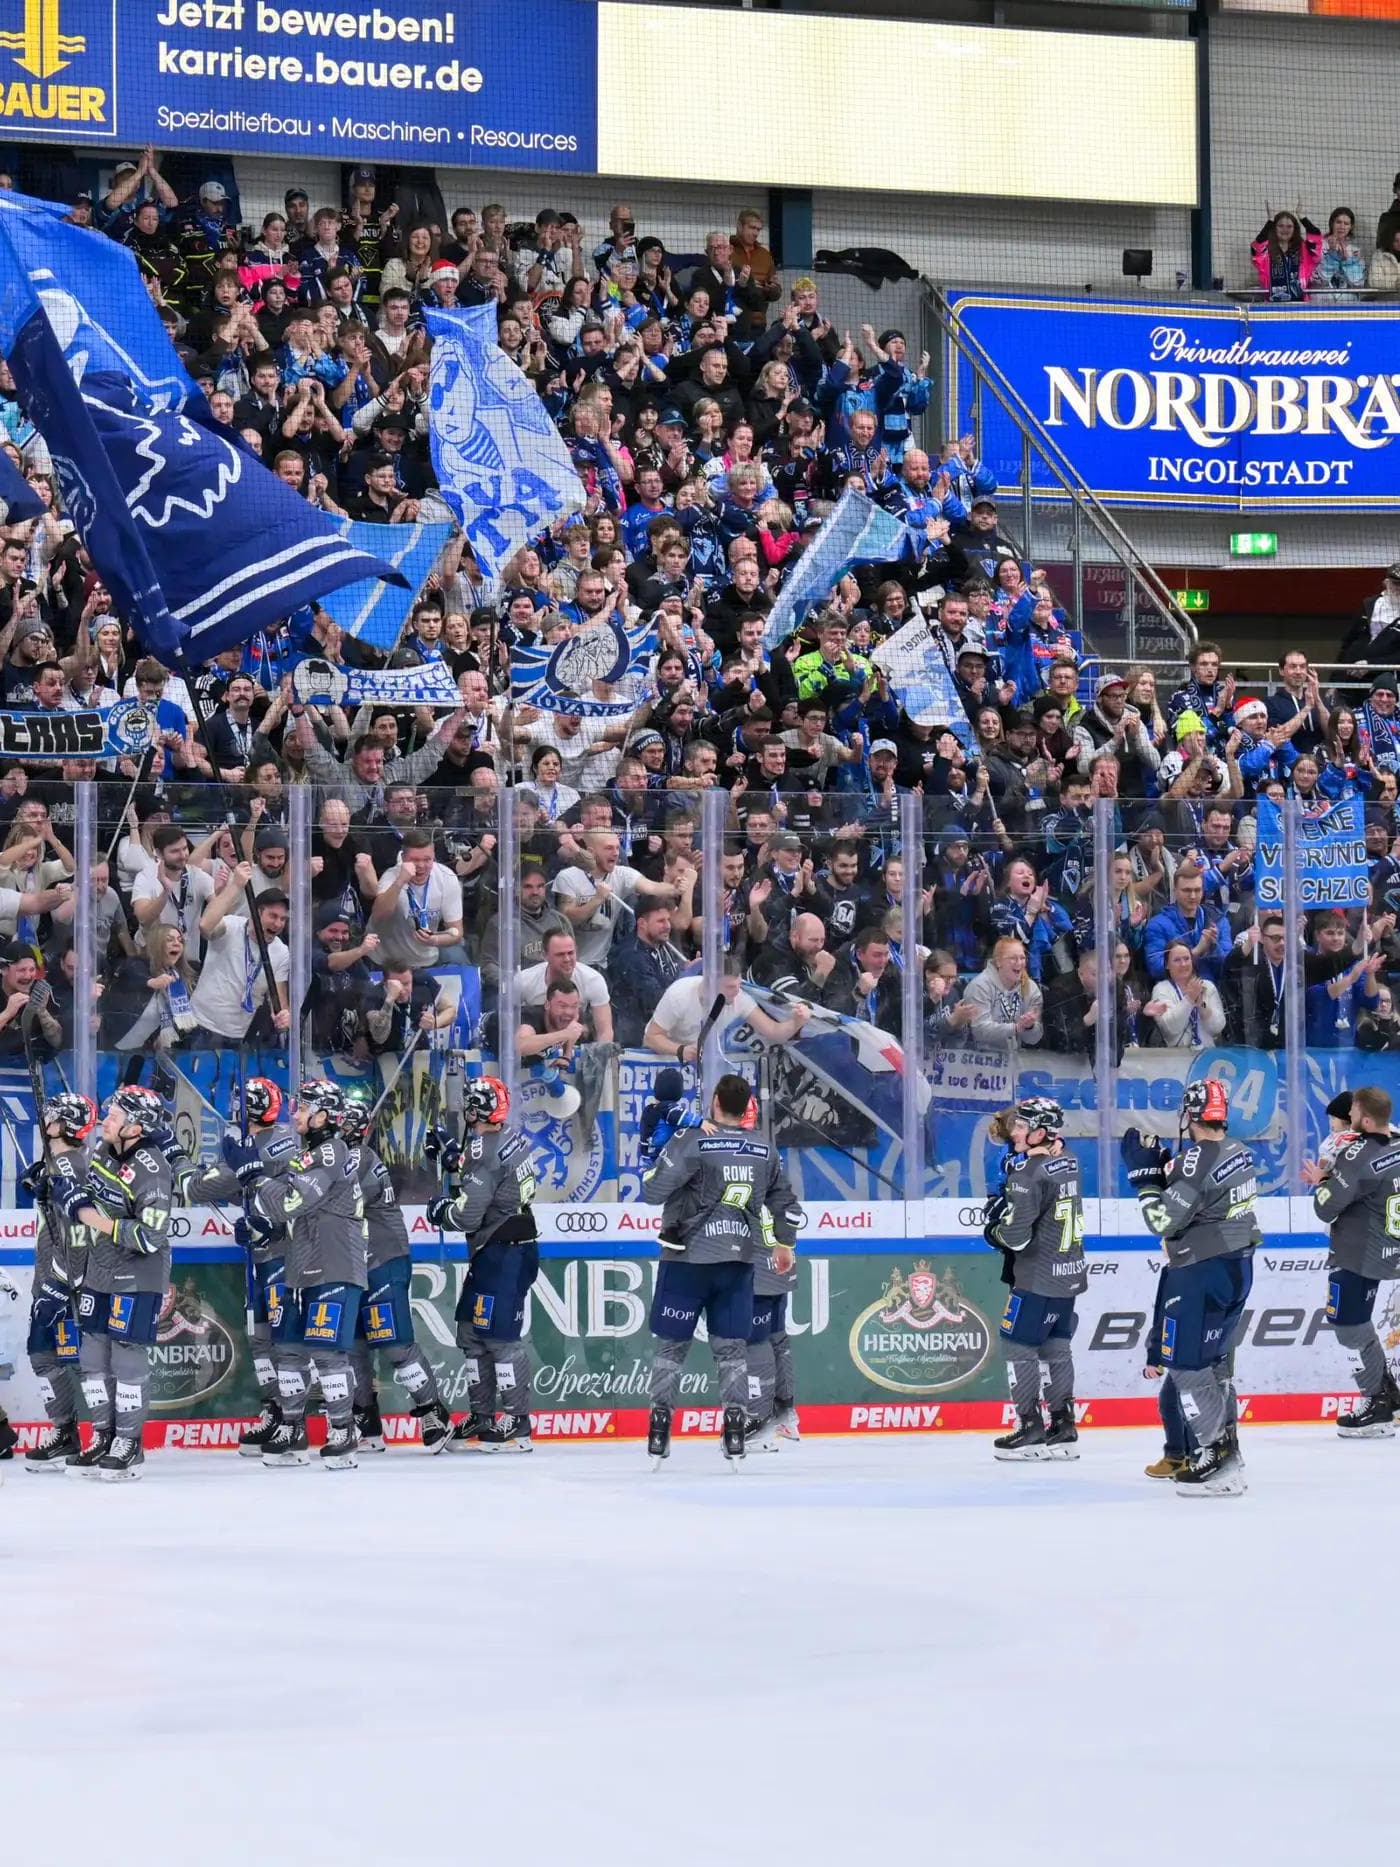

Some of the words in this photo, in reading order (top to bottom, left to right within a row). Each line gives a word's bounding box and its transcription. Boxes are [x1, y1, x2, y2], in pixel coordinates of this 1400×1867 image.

[256, 0, 455, 44] bewerben!
[158, 42, 484, 92] karriere.bauer.de
[157, 105, 312, 138] Spezialtiefbau
[332, 117, 450, 144] Maschinen
[470, 125, 578, 152] Resources
[1149, 326, 1353, 367] Privatbrauerei
[1148, 456, 1353, 486] INGOLSTADT
[723, 1165, 755, 1183] ROWE
[817, 1211, 874, 1231] Audi
[70, 1224, 87, 1247] 12
[660, 1305, 695, 1321] JOOP!
[863, 1332, 982, 1353] HERRNBRÄU
